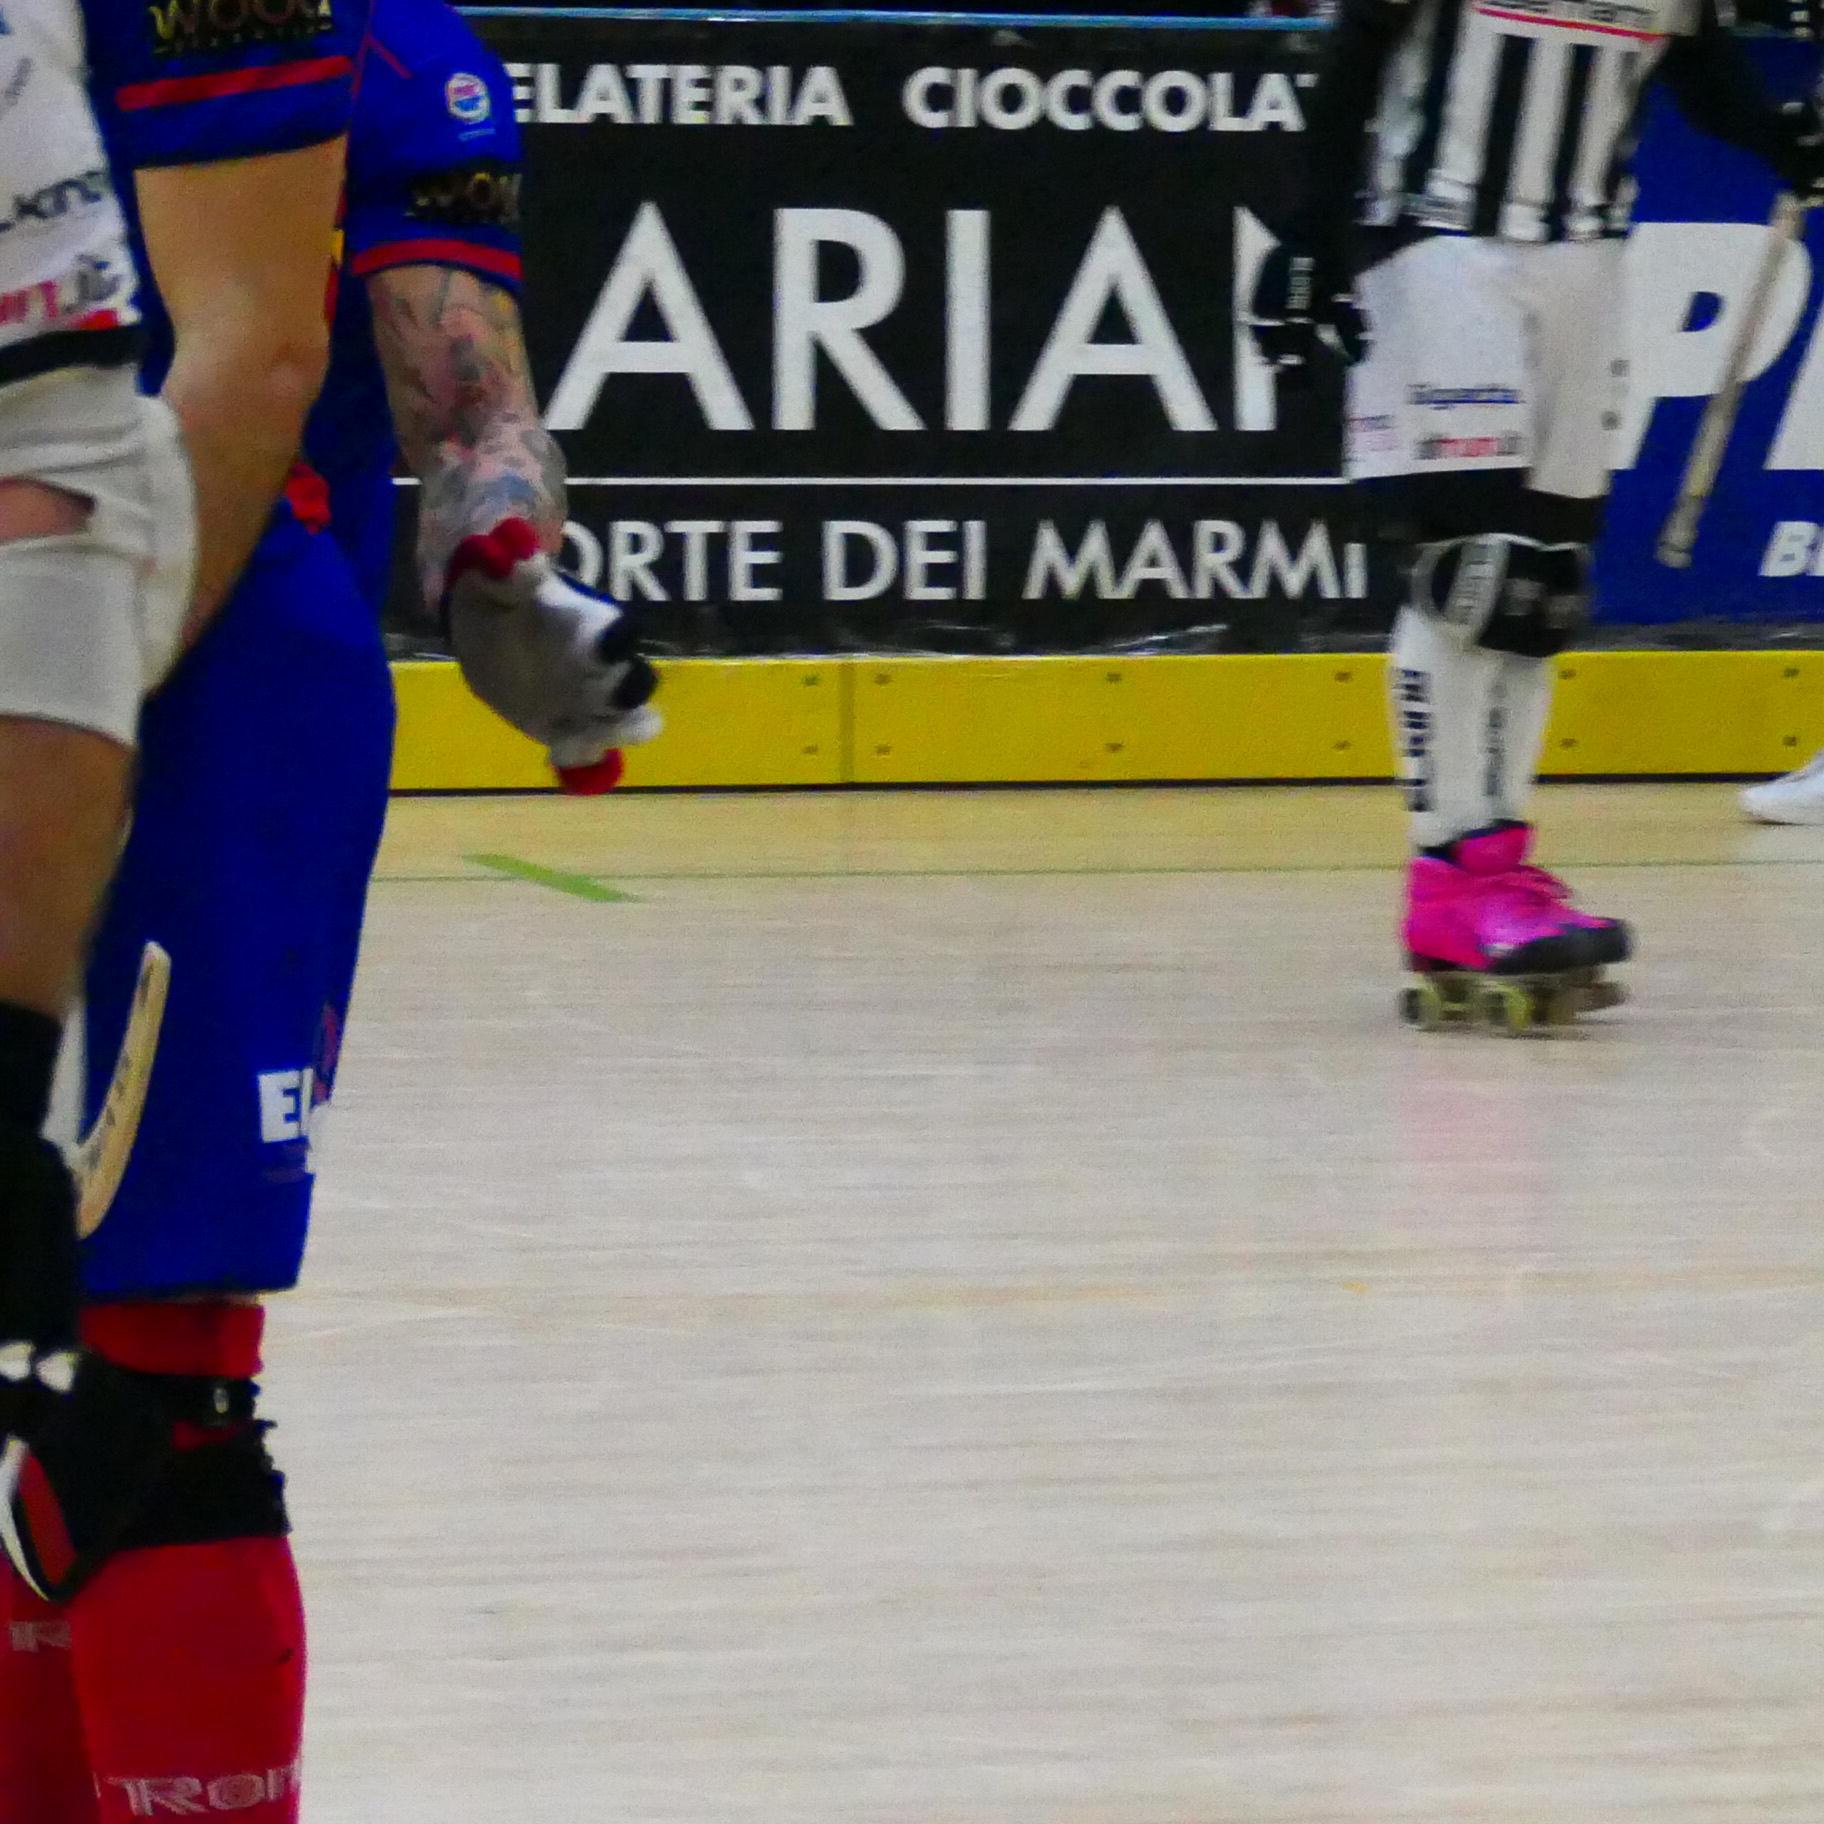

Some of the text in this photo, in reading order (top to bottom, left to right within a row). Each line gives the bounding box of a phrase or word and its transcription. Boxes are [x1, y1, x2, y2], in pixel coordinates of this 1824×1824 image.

[505, 62, 1316, 133] ELATERIA CIOCCOLA
[544, 201, 1279, 432] ARIA
[562, 519, 1368, 602] ORTE DEI MARMI
